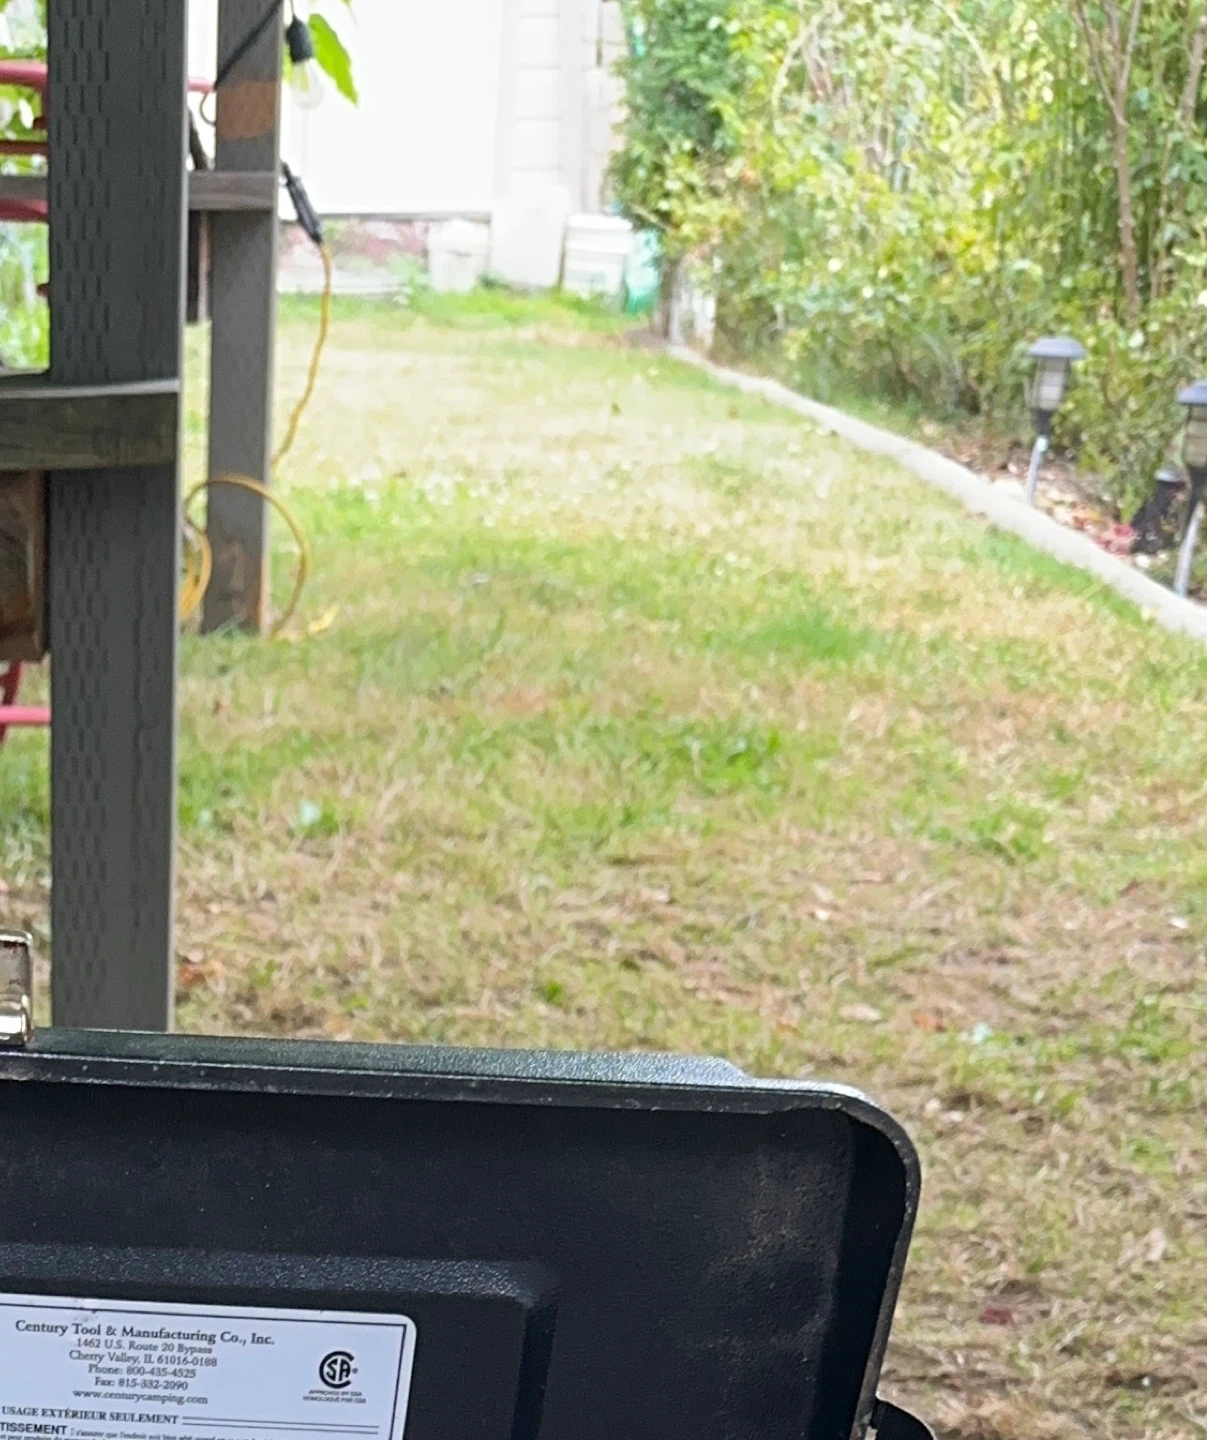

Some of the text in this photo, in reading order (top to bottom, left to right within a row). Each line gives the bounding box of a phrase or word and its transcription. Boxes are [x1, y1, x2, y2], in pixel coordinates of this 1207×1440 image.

[15, 1319, 69, 1335] Century
[71, 1321, 101, 1336] Tool
[105, 1325, 117, 1336] &
[121, 1326, 217, 1345] Manufacturing
[250, 1332, 275, 1345] Inc.
[77, 1338, 213, 1355] 1462 U.S. Route 20 Bypass
[69, 1350, 105, 1363] Cherry
[107, 1351, 141, 1365] Valley,
[143, 1353, 155, 1364] IL
[88, 1362, 197, 1379] Phone: 800-435-4525
[94, 1376, 115, 1387] Fax:
[72, 1390, 208, 1405] www.centurycamping.com
[2, 1406, 39, 1417] USAGE
[41, 1408, 107, 1421] EXTÉRIEUR
[109, 1412, 179, 1425] SEULEMENT
